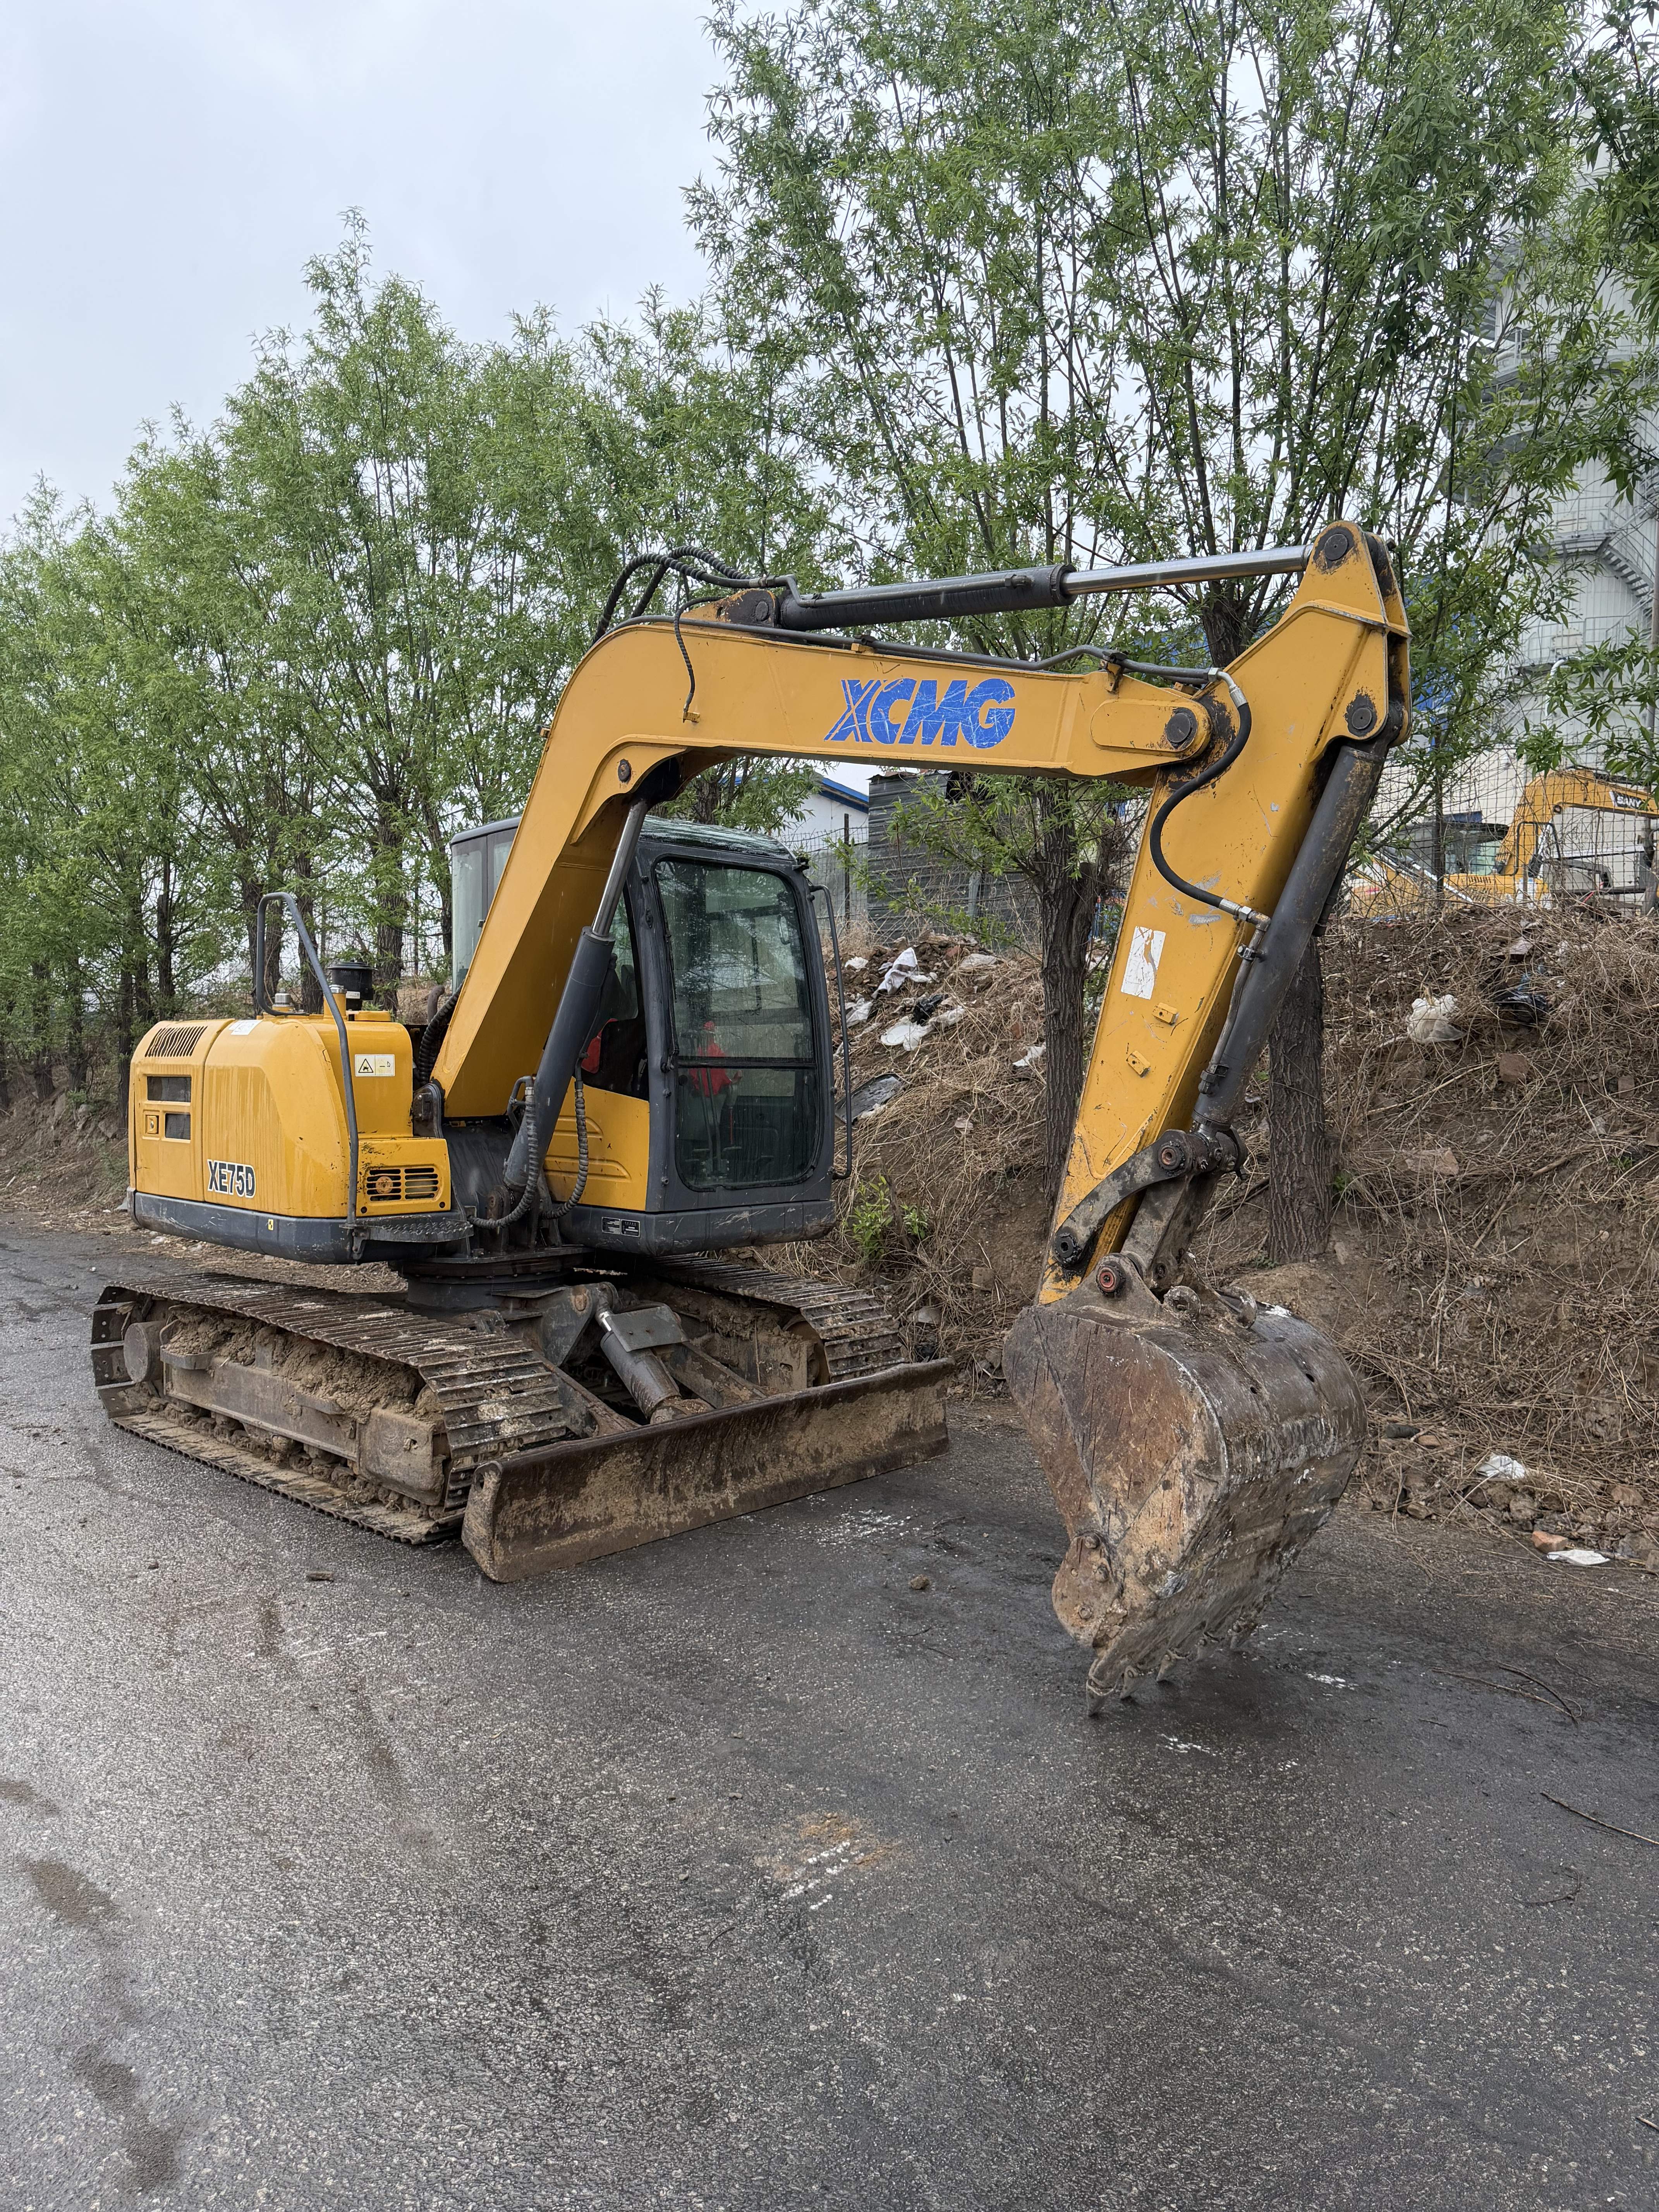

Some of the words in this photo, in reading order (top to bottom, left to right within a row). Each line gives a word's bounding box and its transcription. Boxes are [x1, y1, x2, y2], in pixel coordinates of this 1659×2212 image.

[824, 678, 1015, 749] XCMG
[1617, 796, 1642, 807] SANY
[207, 1159, 256, 1198] XE75D
